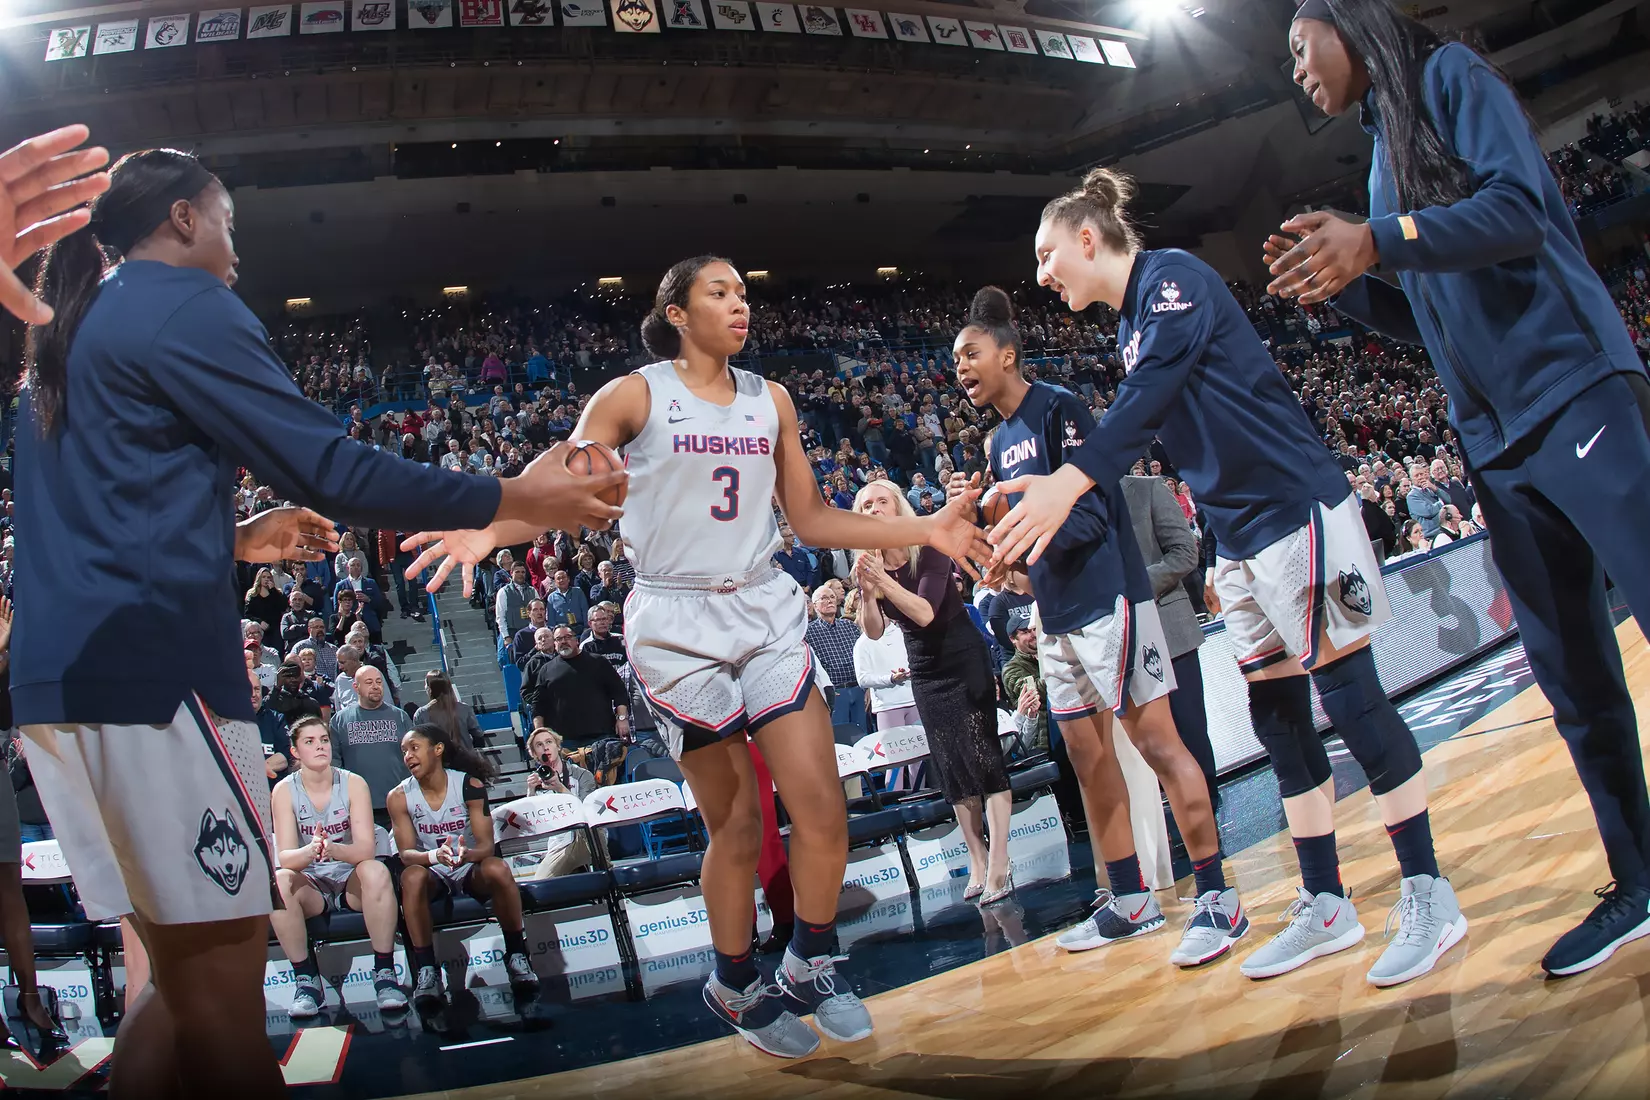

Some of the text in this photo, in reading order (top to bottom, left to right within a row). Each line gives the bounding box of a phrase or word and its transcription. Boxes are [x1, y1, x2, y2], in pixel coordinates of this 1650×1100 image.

[716, 5, 747, 24] UCF
[200, 21, 239, 34] UNH
[1152, 301, 1192, 313] UCONN
[673, 434, 770, 456] HUSKIES
[1061, 438, 1085, 449] UCONN
[711, 466, 740, 522] 3
[717, 586, 738, 594] UCONN
[1398, 557, 1481, 656] 3
[347, 720, 398, 733] OSSINING
[348, 730, 399, 746] BASKETBALL
[887, 734, 929, 750] TICKE
[889, 742, 928, 755] GALAX
[620, 788, 671, 804] TICKET
[623, 796, 673, 811] GALAXY
[522, 803, 573, 819] TICKET
[526, 811, 575, 827] GALAXY
[300, 820, 350, 836] HUKIES
[418, 820, 464, 835] HUSKIES
[1005, 820, 1056, 842] enius3D
[40, 853, 60, 862] TIC
[917, 842, 968, 871] genius3
[843, 867, 900, 889] enius3D
[635, 909, 709, 939] genius3D
[532, 928, 609, 955] genius3D
[55, 985, 89, 999] us3D
